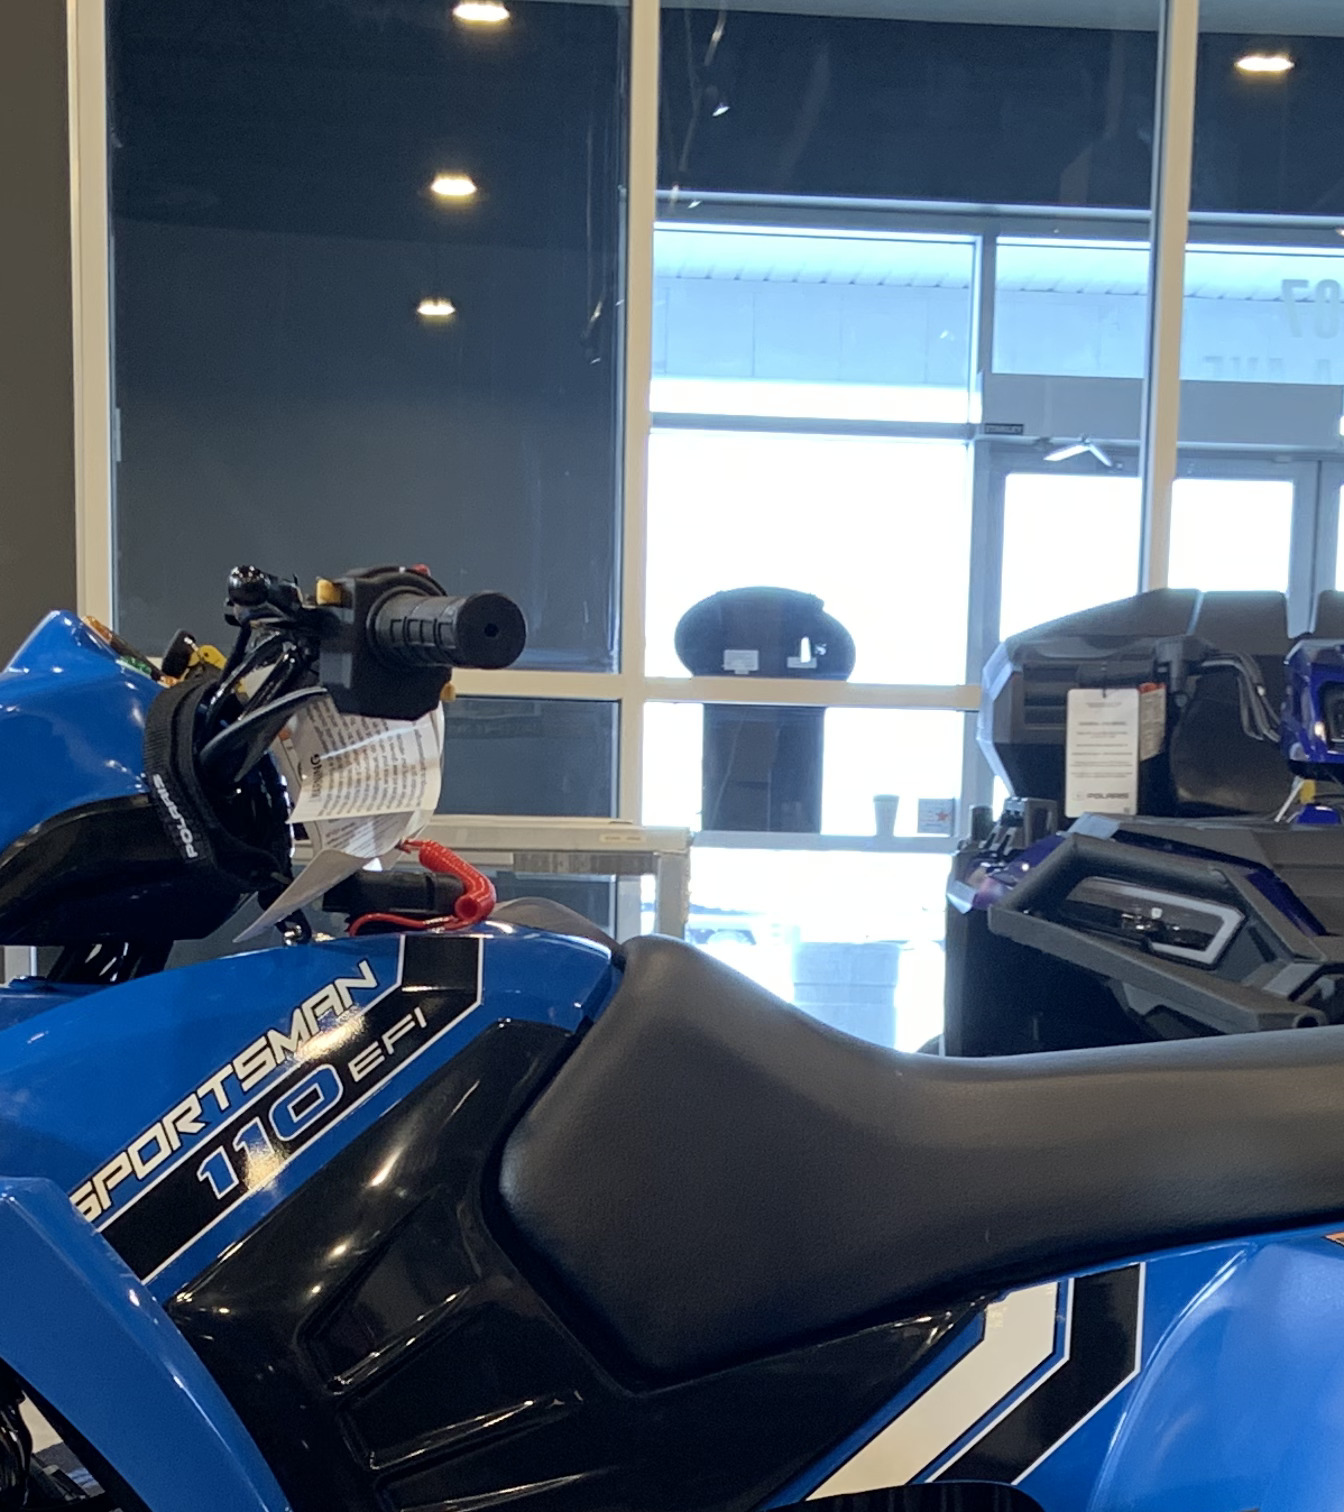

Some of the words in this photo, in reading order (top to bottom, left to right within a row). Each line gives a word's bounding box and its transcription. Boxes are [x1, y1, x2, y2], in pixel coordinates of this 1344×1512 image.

[152, 773, 198, 859] POLARIS
[68, 959, 378, 1223] SPORTSMAN
[196, 1063, 345, 1200] 110
[346, 1006, 428, 1083] EFI
